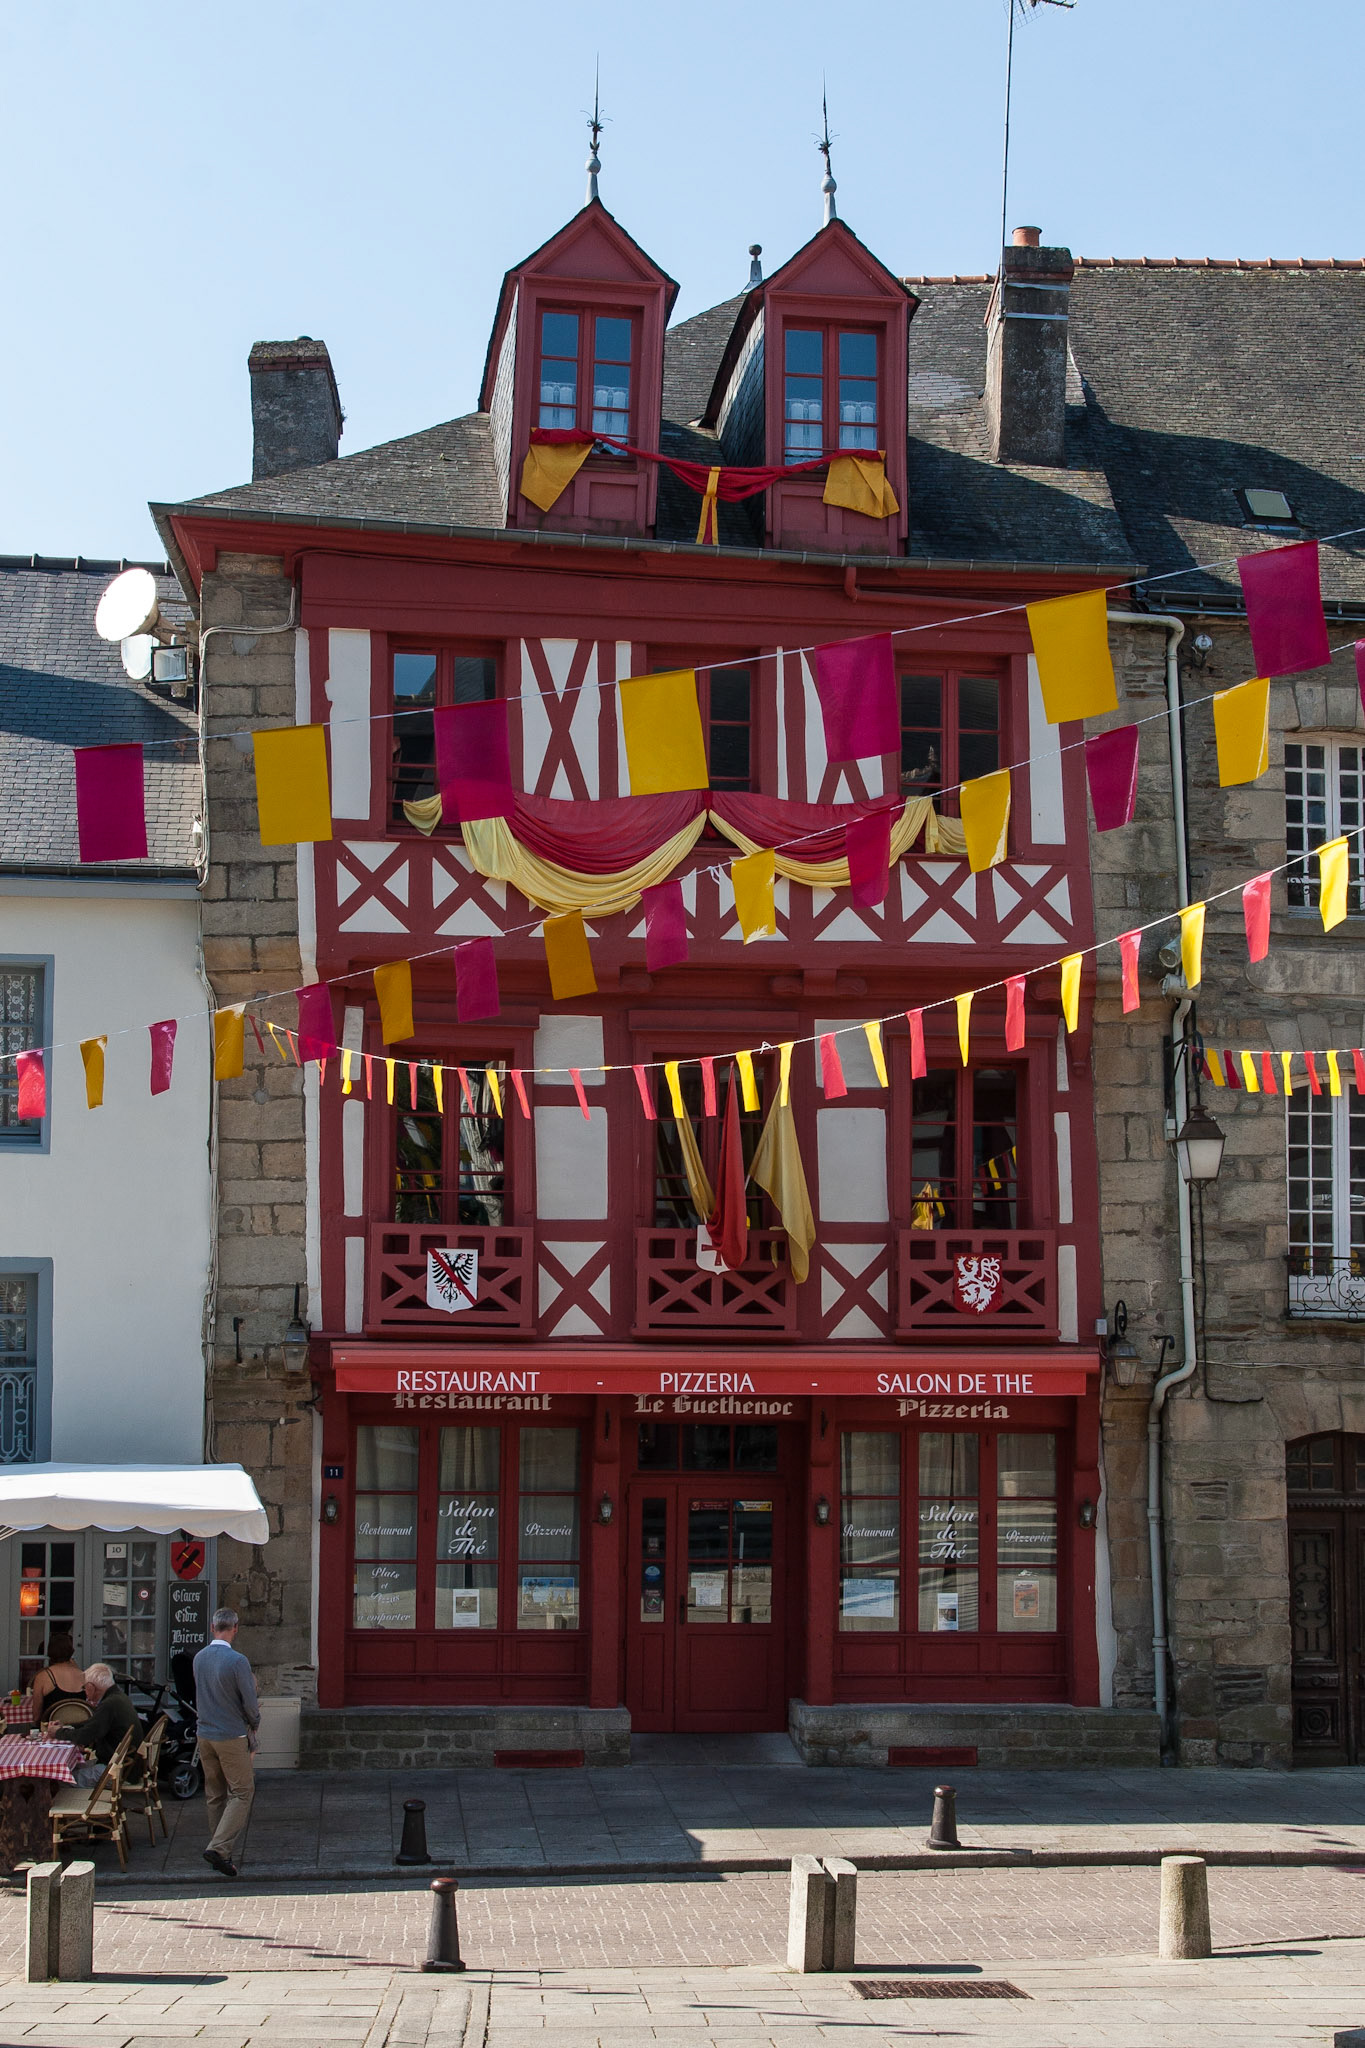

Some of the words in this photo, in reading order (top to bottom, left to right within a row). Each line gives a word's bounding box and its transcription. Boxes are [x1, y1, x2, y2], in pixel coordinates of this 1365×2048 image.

[397, 1371, 540, 1391] RESTAURANT
[660, 1373, 755, 1392] PIZZERIA
[877, 1374, 951, 1393] SALON
[958, 1374, 986, 1393] DE
[992, 1374, 1034, 1393] THE
[392, 1392, 553, 1411] Restaurant
[634, 1394, 664, 1413] Le
[672, 1394, 794, 1415] Guethenoc
[896, 1399, 1010, 1419] Pizzeria
[329, 1468, 339, 1477] 11
[439, 1500, 495, 1518] Salon
[920, 1505, 975, 1522] Salon
[358, 1522, 413, 1536] Restaurant
[455, 1520, 477, 1536] de
[524, 1522, 573, 1536] Pizzeria
[842, 1524, 896, 1537] Restaurant
[936, 1524, 958, 1540] de
[1005, 1529, 1051, 1543] Pizzeria
[111, 1546, 122, 1554] 10
[447, 1537, 488, 1555] Thé
[929, 1542, 968, 1559] Thé
[370, 1567, 400, 1579] Plats
[172, 1588, 202, 1602] Glaces
[174, 1605, 198, 1623] Cidre
[366, 1612, 411, 1625] emporter
[171, 1628, 205, 1645] Bières
